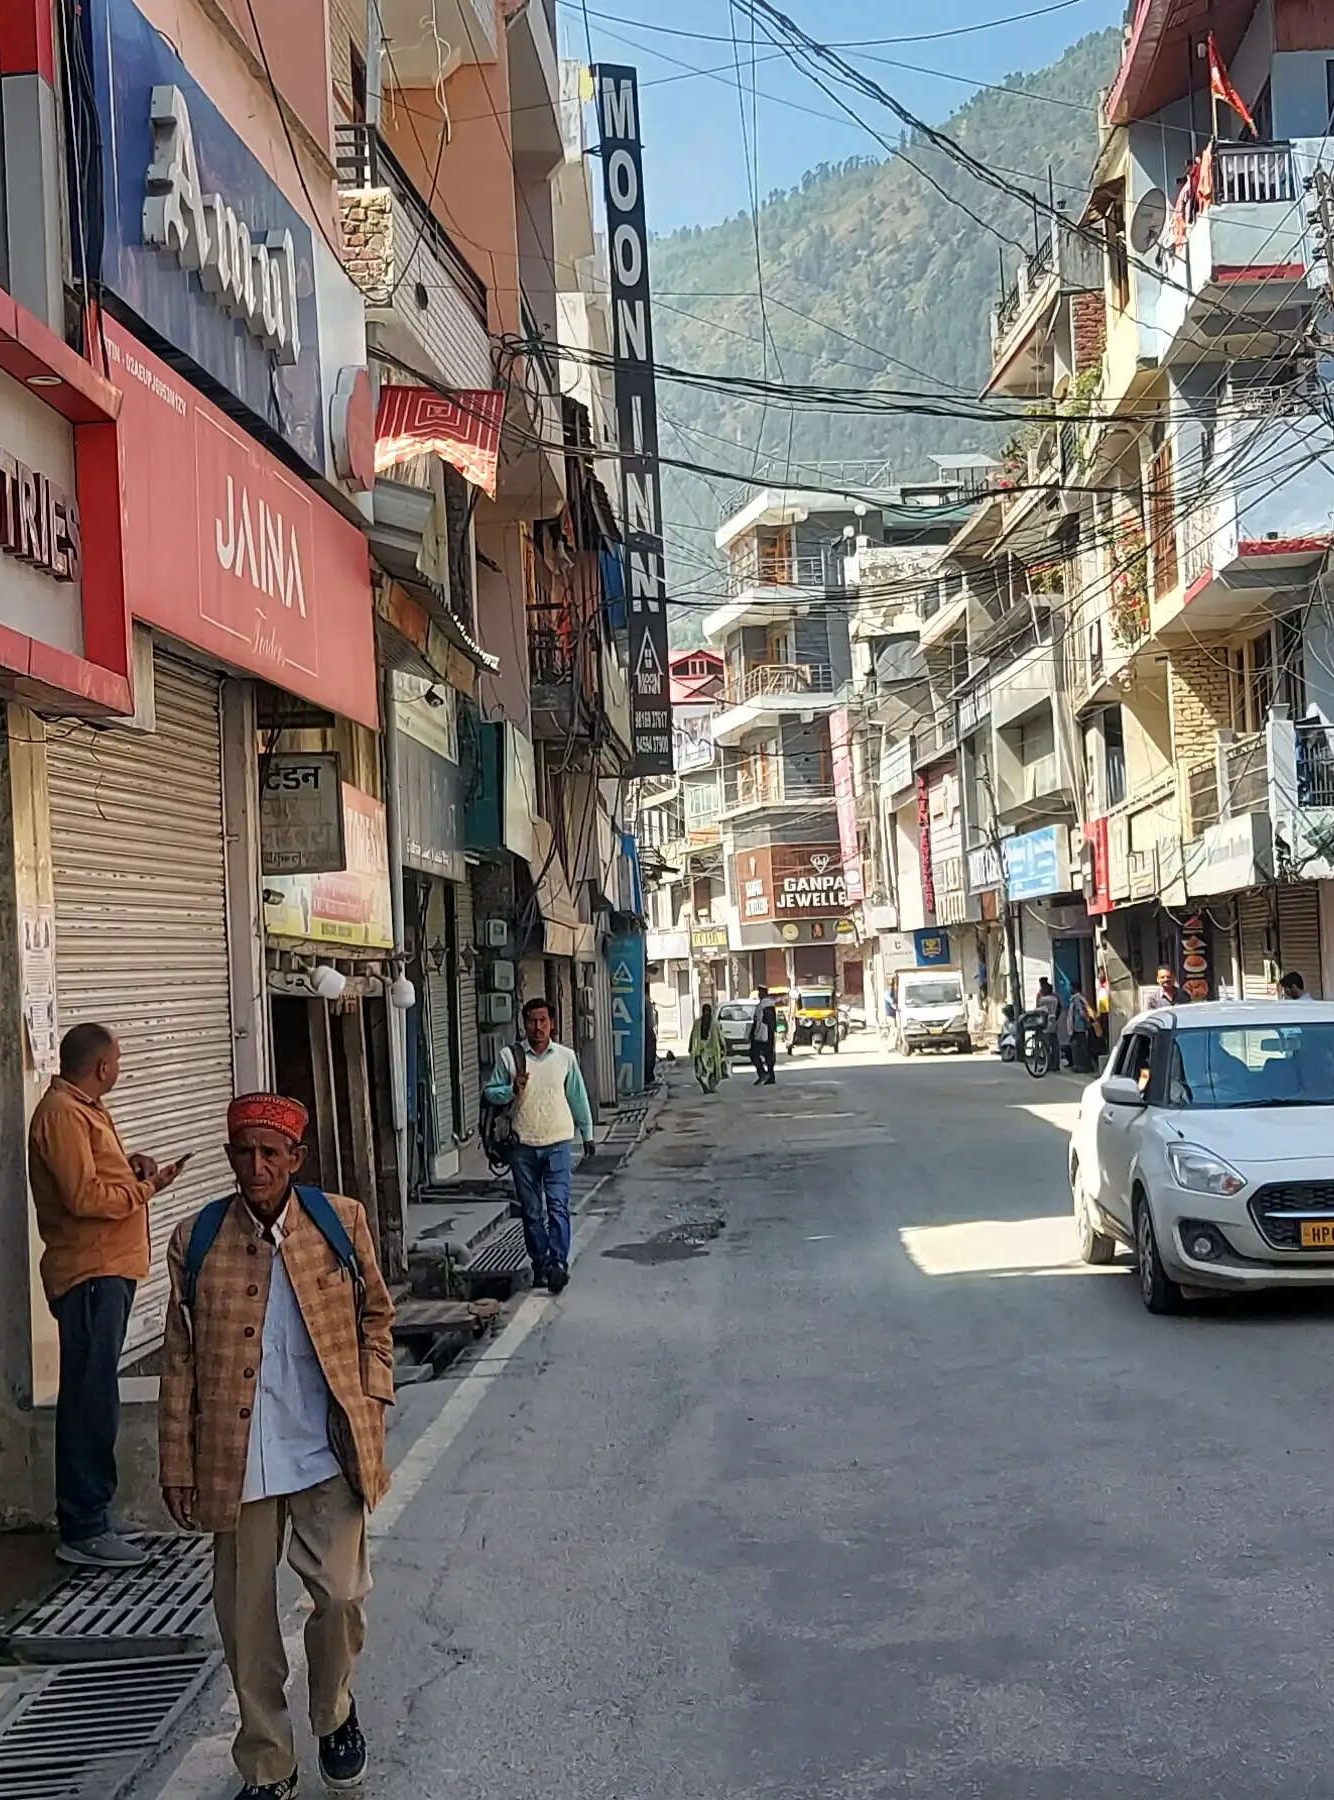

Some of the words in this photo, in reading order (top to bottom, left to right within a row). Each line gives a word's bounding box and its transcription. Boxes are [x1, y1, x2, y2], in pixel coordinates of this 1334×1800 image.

[601, 76, 649, 361] MOON
[630, 402, 661, 613] INN
[215, 473, 307, 620] JAINA
[776, 892, 849, 908] JEWELLE
[784, 876, 846, 892] GANPA
